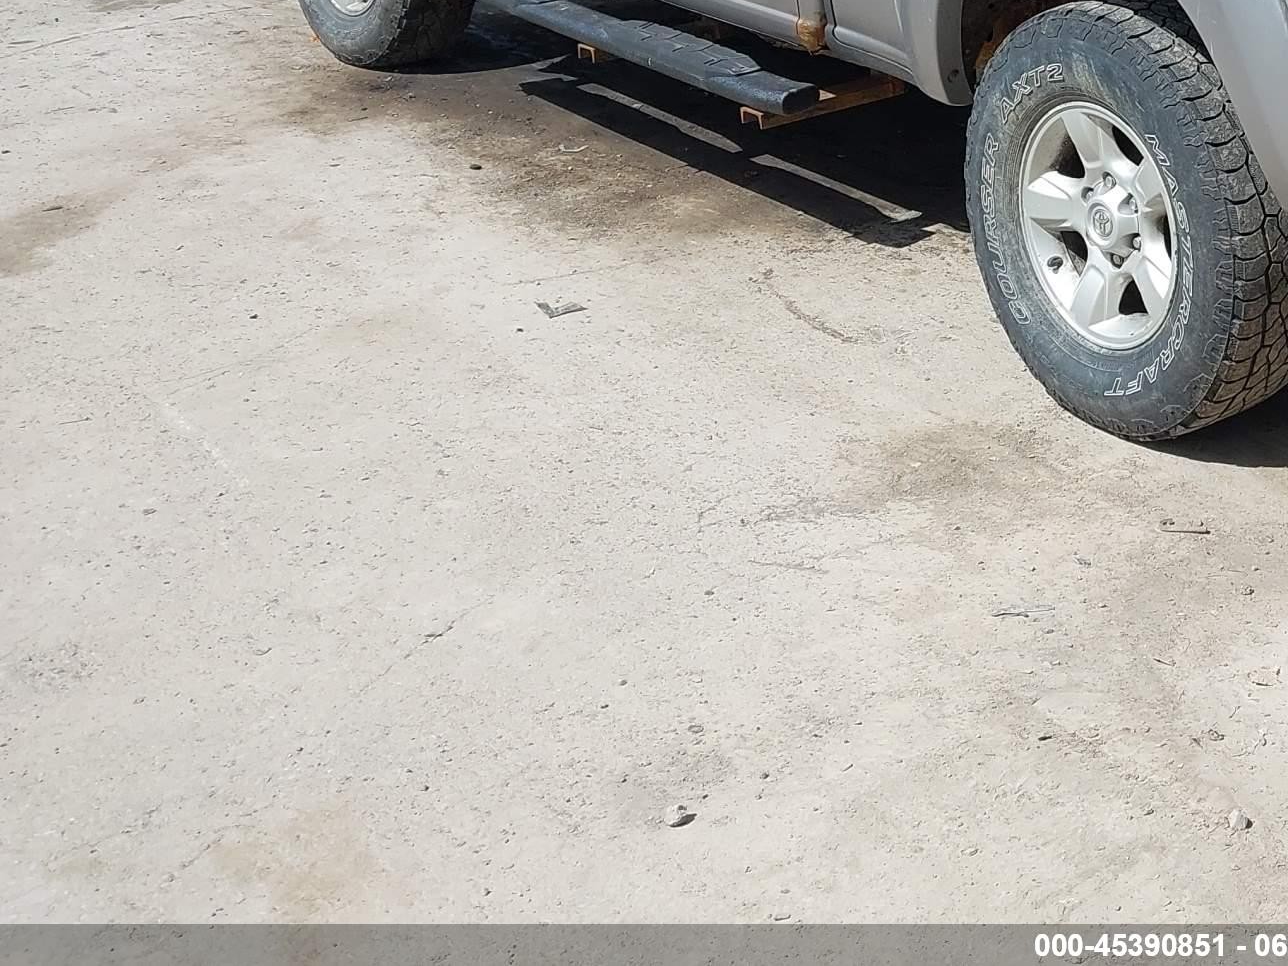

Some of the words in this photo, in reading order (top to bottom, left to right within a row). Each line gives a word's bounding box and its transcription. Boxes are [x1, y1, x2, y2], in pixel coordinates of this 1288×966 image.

[997, 63, 1065, 126] AXT2
[980, 133, 1032, 325] COURSER
[1104, 133, 1195, 397] MASTERCRAFT
